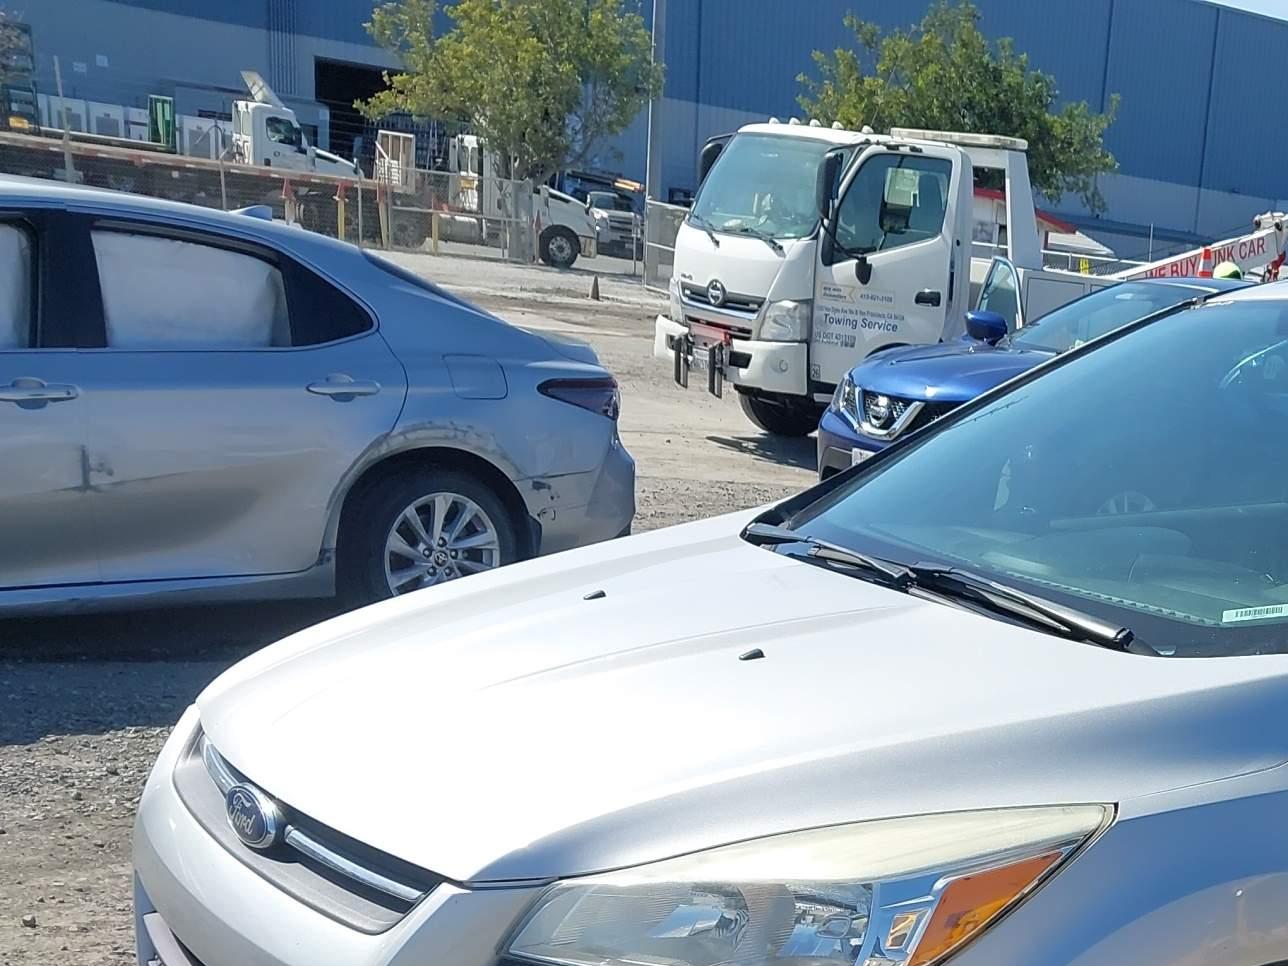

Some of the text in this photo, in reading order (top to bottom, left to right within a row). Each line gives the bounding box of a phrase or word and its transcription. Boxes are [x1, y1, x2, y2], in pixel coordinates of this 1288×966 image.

[1171, 256, 1197, 278] BUY
[1239, 236, 1265, 260] CAR
[823, 313, 898, 332] Towing Service
[229, 791, 256, 835] Ford
